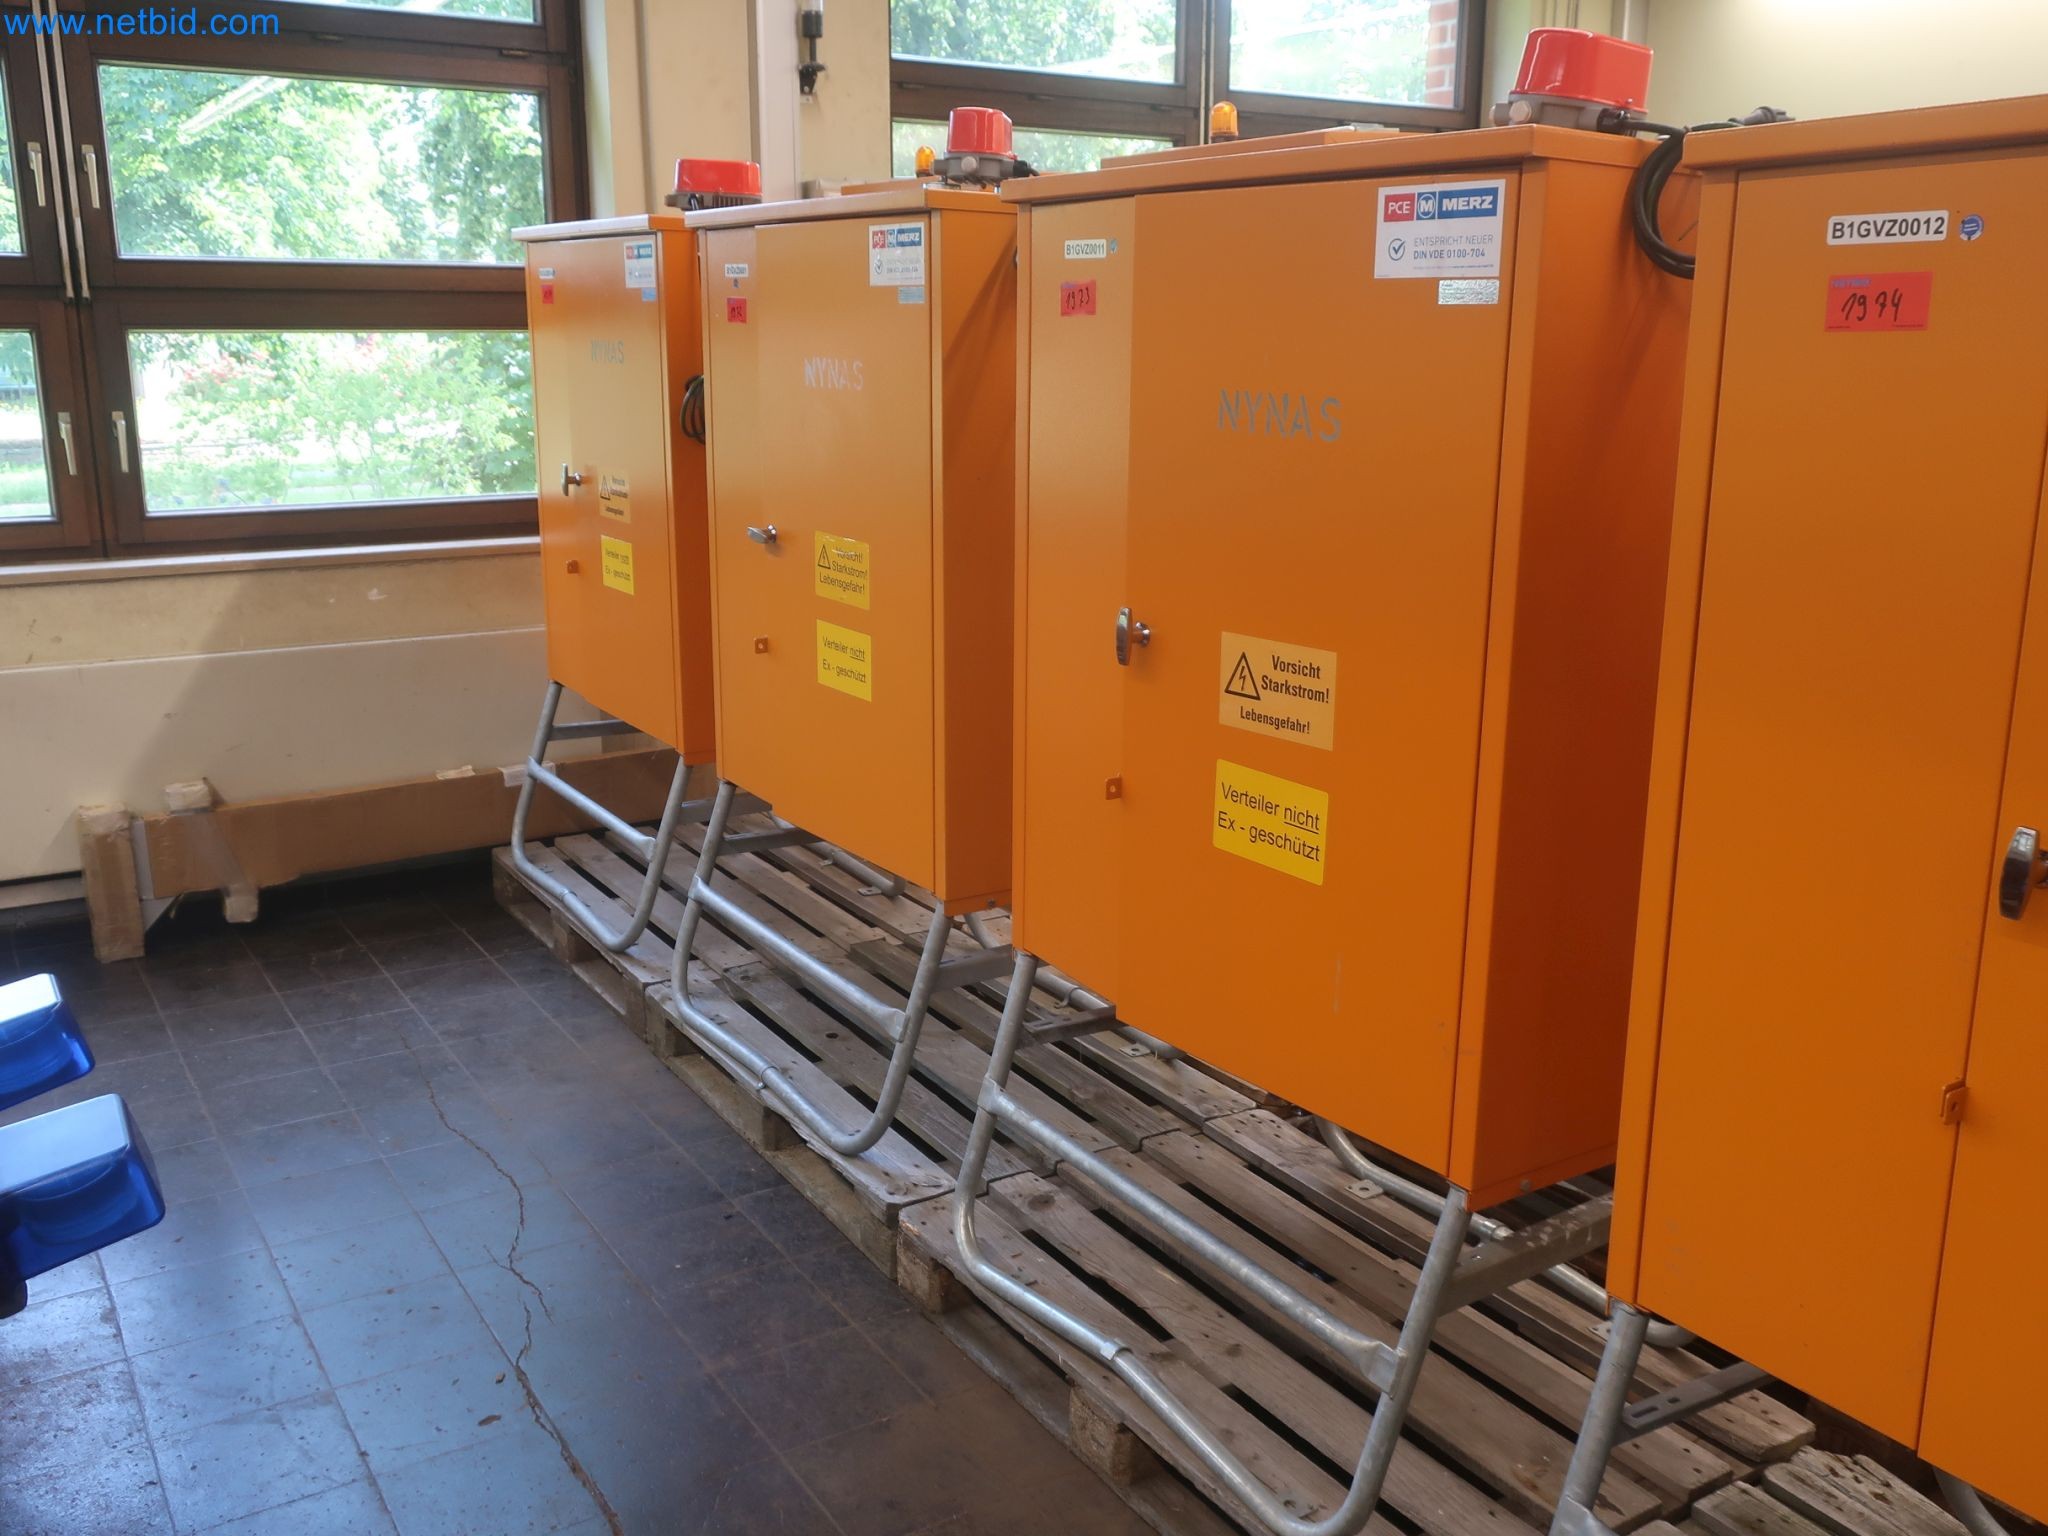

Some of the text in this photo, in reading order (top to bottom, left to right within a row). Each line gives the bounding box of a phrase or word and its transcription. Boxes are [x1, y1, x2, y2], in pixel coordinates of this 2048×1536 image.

[1388, 195, 1494, 214] PCE M MERZ
[1414, 234, 1494, 248] ENTSPRICHT NEUER
[1831, 216, 1946, 240] B1GVZ0012
[1066, 243, 1105, 255] B1GVZ0011
[1413, 248, 1486, 260] DIN VDE 0100-704
[1841, 287, 1903, 322] 1974
[803, 357, 864, 391] NYNAS
[1217, 388, 1342, 443] NYNAS
[822, 635, 865, 662] Verteiler nicht
[822, 658, 831, 671] Ex
[1271, 654, 1321, 680] Vorsicht
[1261, 674, 1330, 704] Starkstrom!
[1240, 705, 1310, 735] Lebensgefahr!
[1221, 781, 1320, 833] Verteiler nicht
[1218, 810, 1236, 832] Ex
[1249, 825, 1321, 862] geschützt
